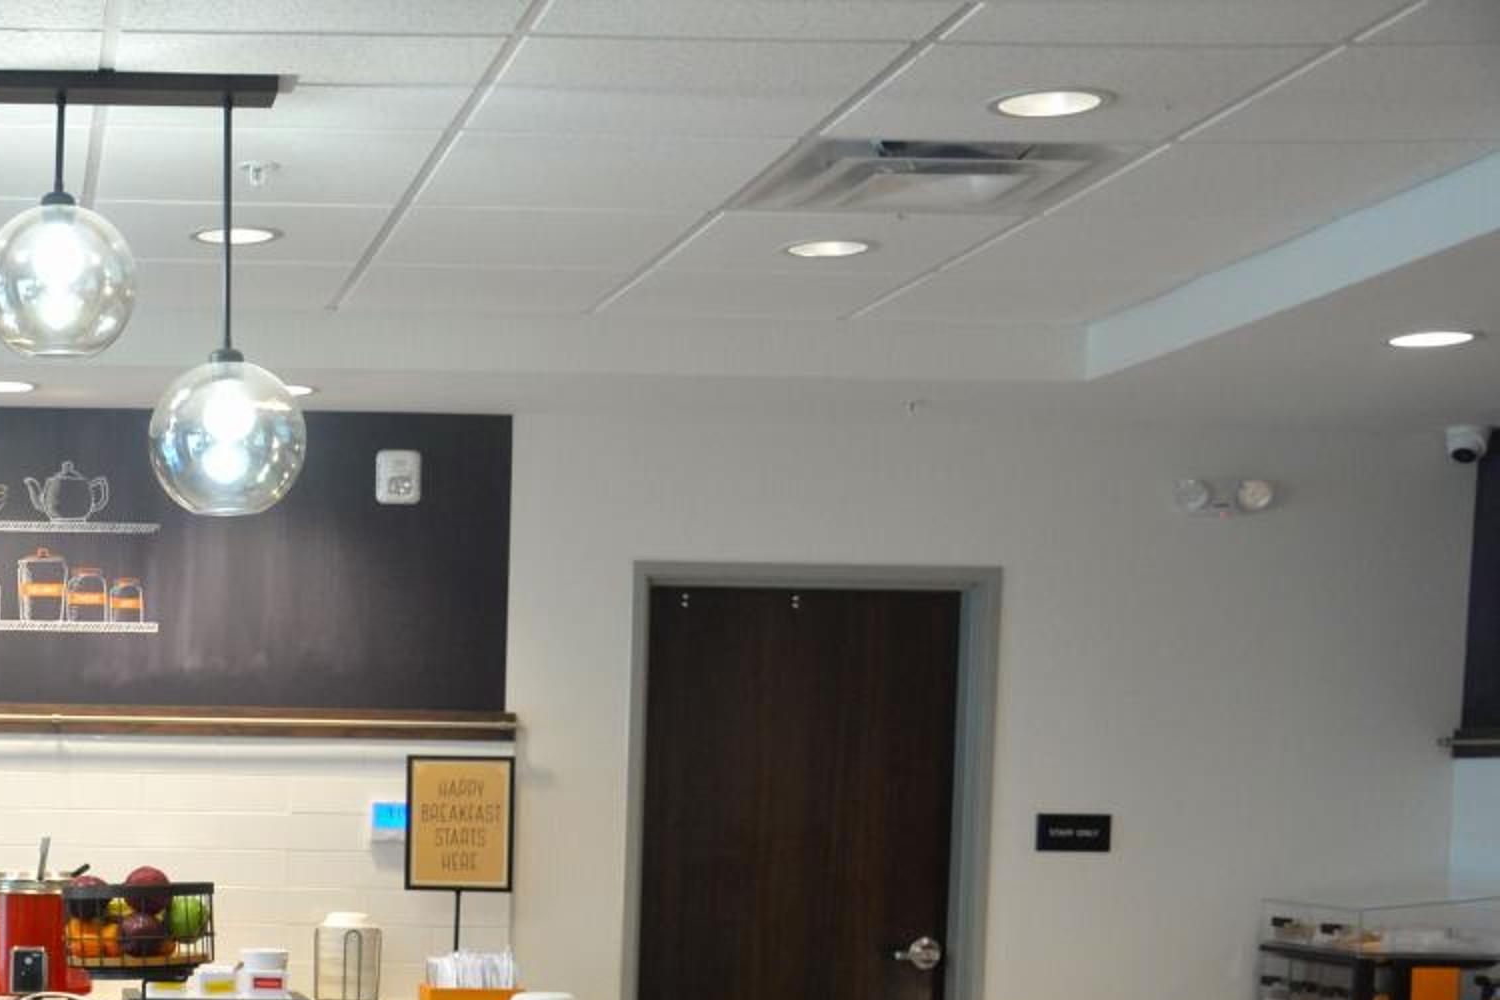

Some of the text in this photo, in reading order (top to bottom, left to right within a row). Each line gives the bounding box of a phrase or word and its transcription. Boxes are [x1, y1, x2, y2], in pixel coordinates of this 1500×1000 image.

[438, 779, 485, 797] HAPPY
[421, 803, 501, 823] BREAKFAST
[435, 827, 485, 848] STARTS
[441, 851, 478, 872] HERE
